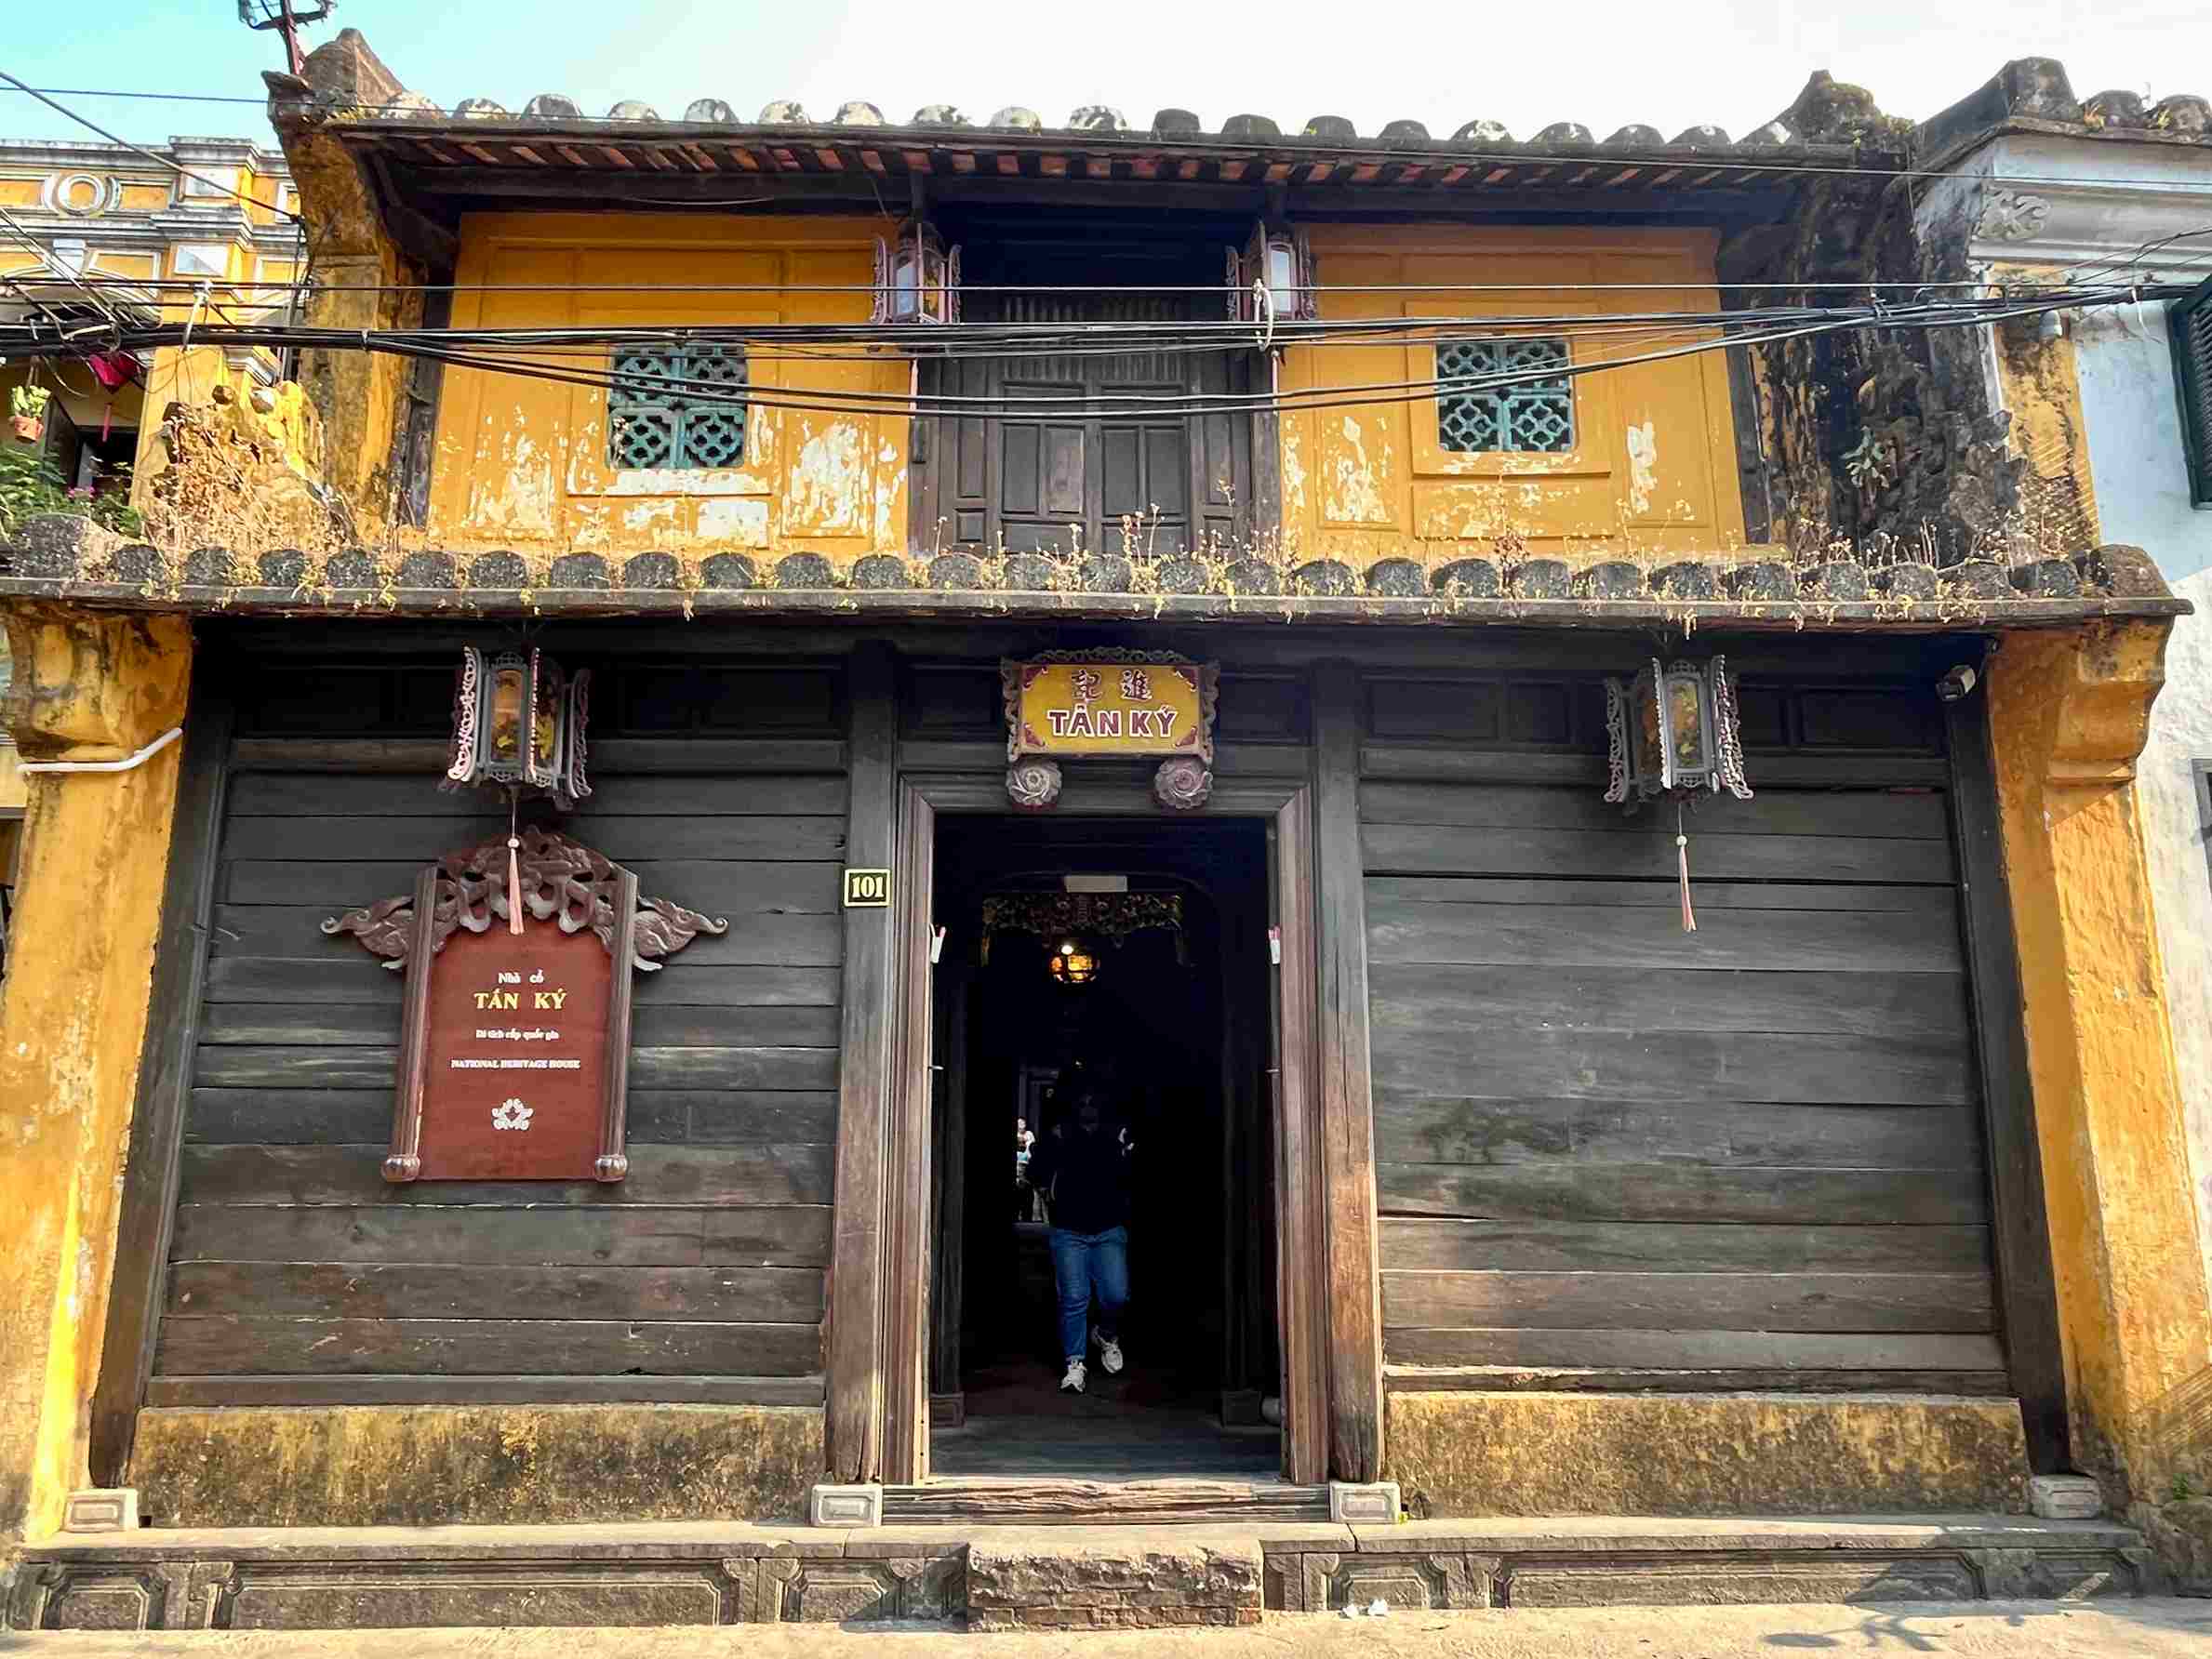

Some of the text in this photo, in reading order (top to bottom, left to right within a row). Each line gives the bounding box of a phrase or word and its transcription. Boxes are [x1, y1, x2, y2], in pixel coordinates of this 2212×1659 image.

[1129, 704, 1179, 737] KÝ
[852, 876, 885, 898] 101
[529, 968, 544, 984] cổ
[535, 988, 567, 1010] KÝ
[451, 1059, 580, 1068] NATIONAL HERITAGE HOUSE
